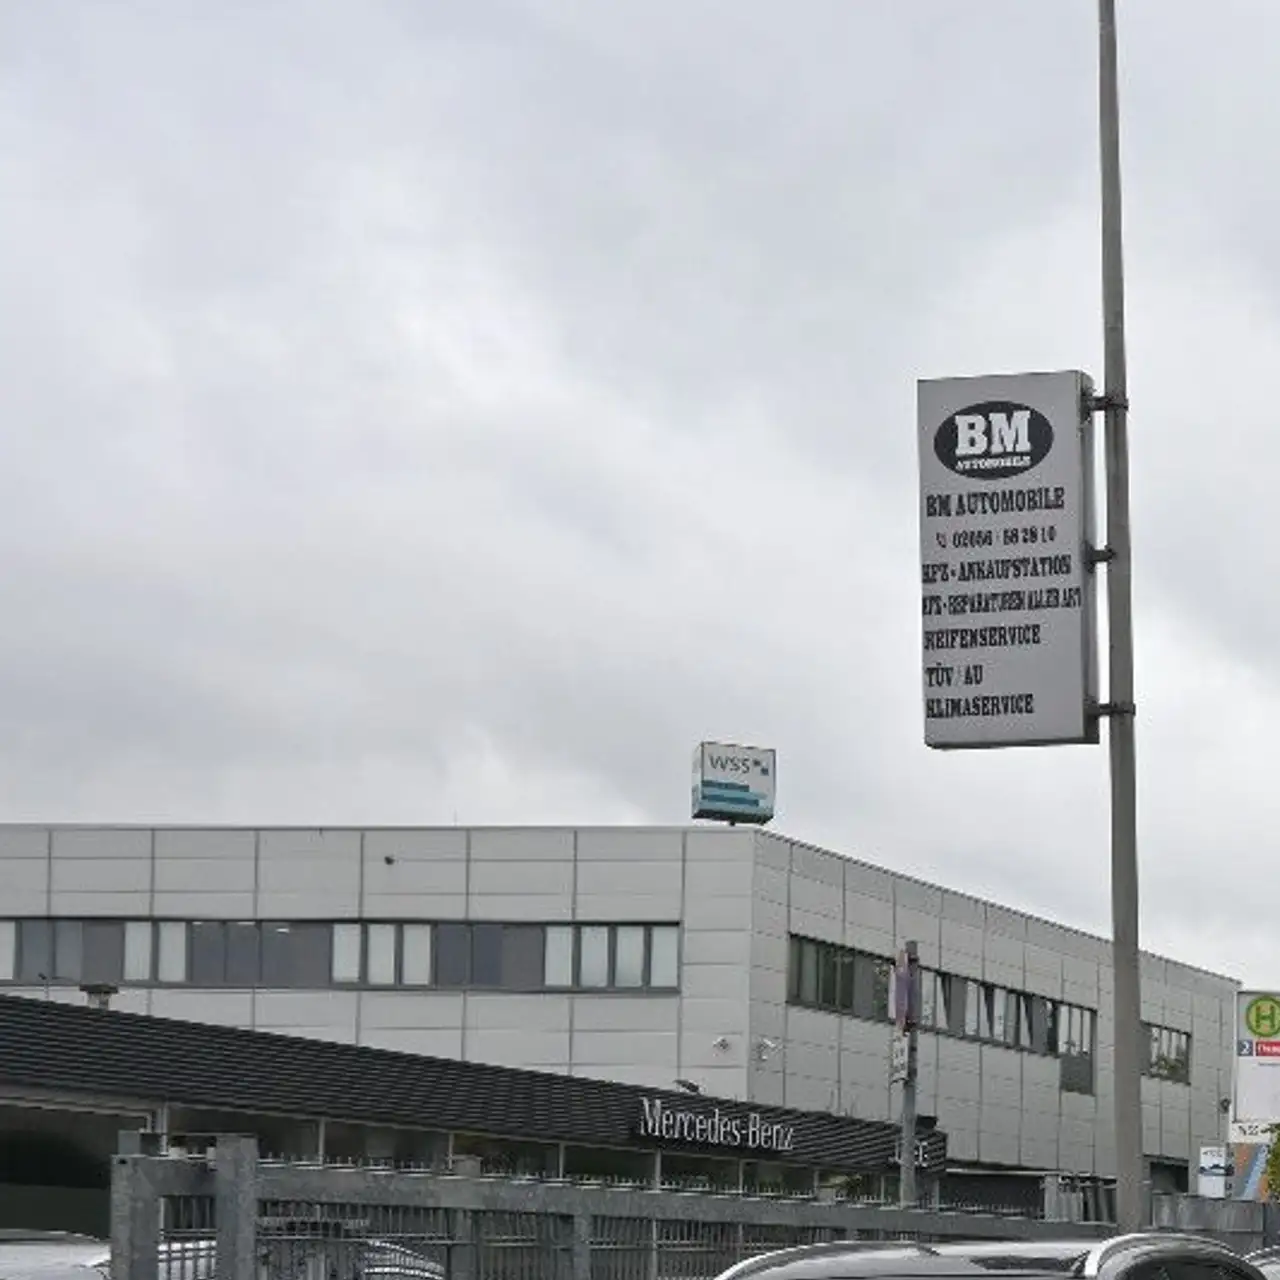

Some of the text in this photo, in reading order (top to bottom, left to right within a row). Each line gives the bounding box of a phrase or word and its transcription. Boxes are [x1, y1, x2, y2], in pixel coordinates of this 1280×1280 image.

[955, 410, 1031, 455] BM
[926, 487, 1065, 517] BM AUTOMOBILE
[953, 530, 992, 548] 02056
[1022, 526, 1038, 543] 28
[924, 624, 1041, 650] REIFENSERVICE
[926, 663, 983, 687] TÜV AU
[926, 694, 1034, 719] KLIMASERVICE
[639, 1096, 795, 1150] Mercedes-Benz
